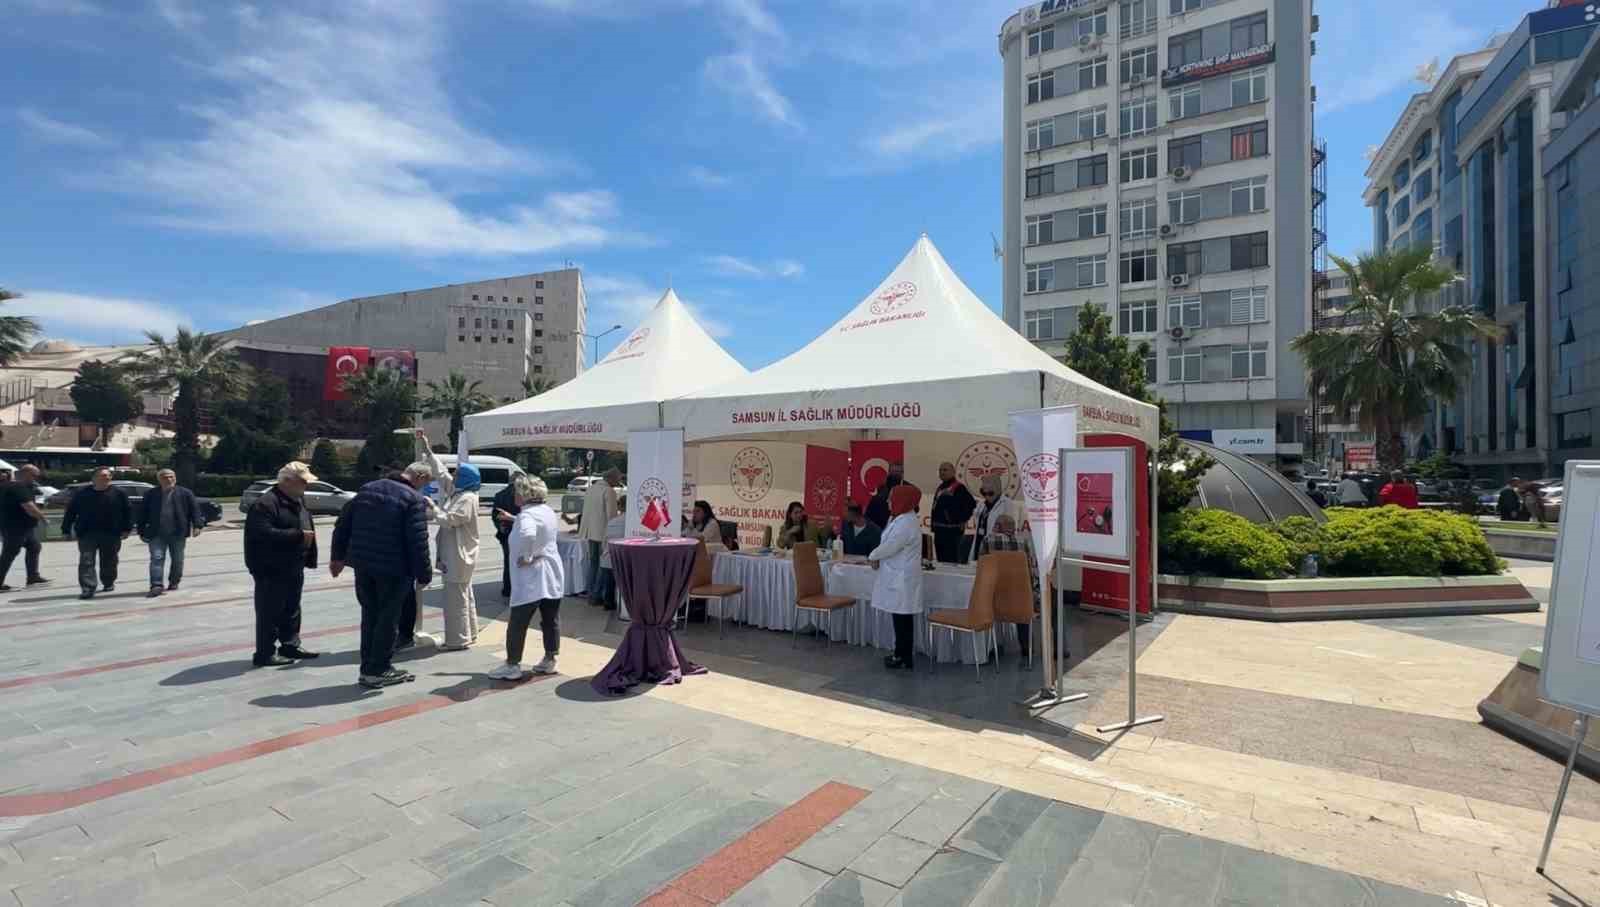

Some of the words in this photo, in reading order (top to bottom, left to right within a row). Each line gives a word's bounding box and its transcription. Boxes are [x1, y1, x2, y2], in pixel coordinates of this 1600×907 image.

[732, 411, 775, 424] SAMSUN
[777, 408, 787, 422] İL
[790, 406, 834, 422] SAĞLIK
[837, 402, 922, 420] MÜDÜRLÜĞÜ
[718, 504, 750, 518] SAĞLIK
[751, 507, 785, 520] BAKAN
